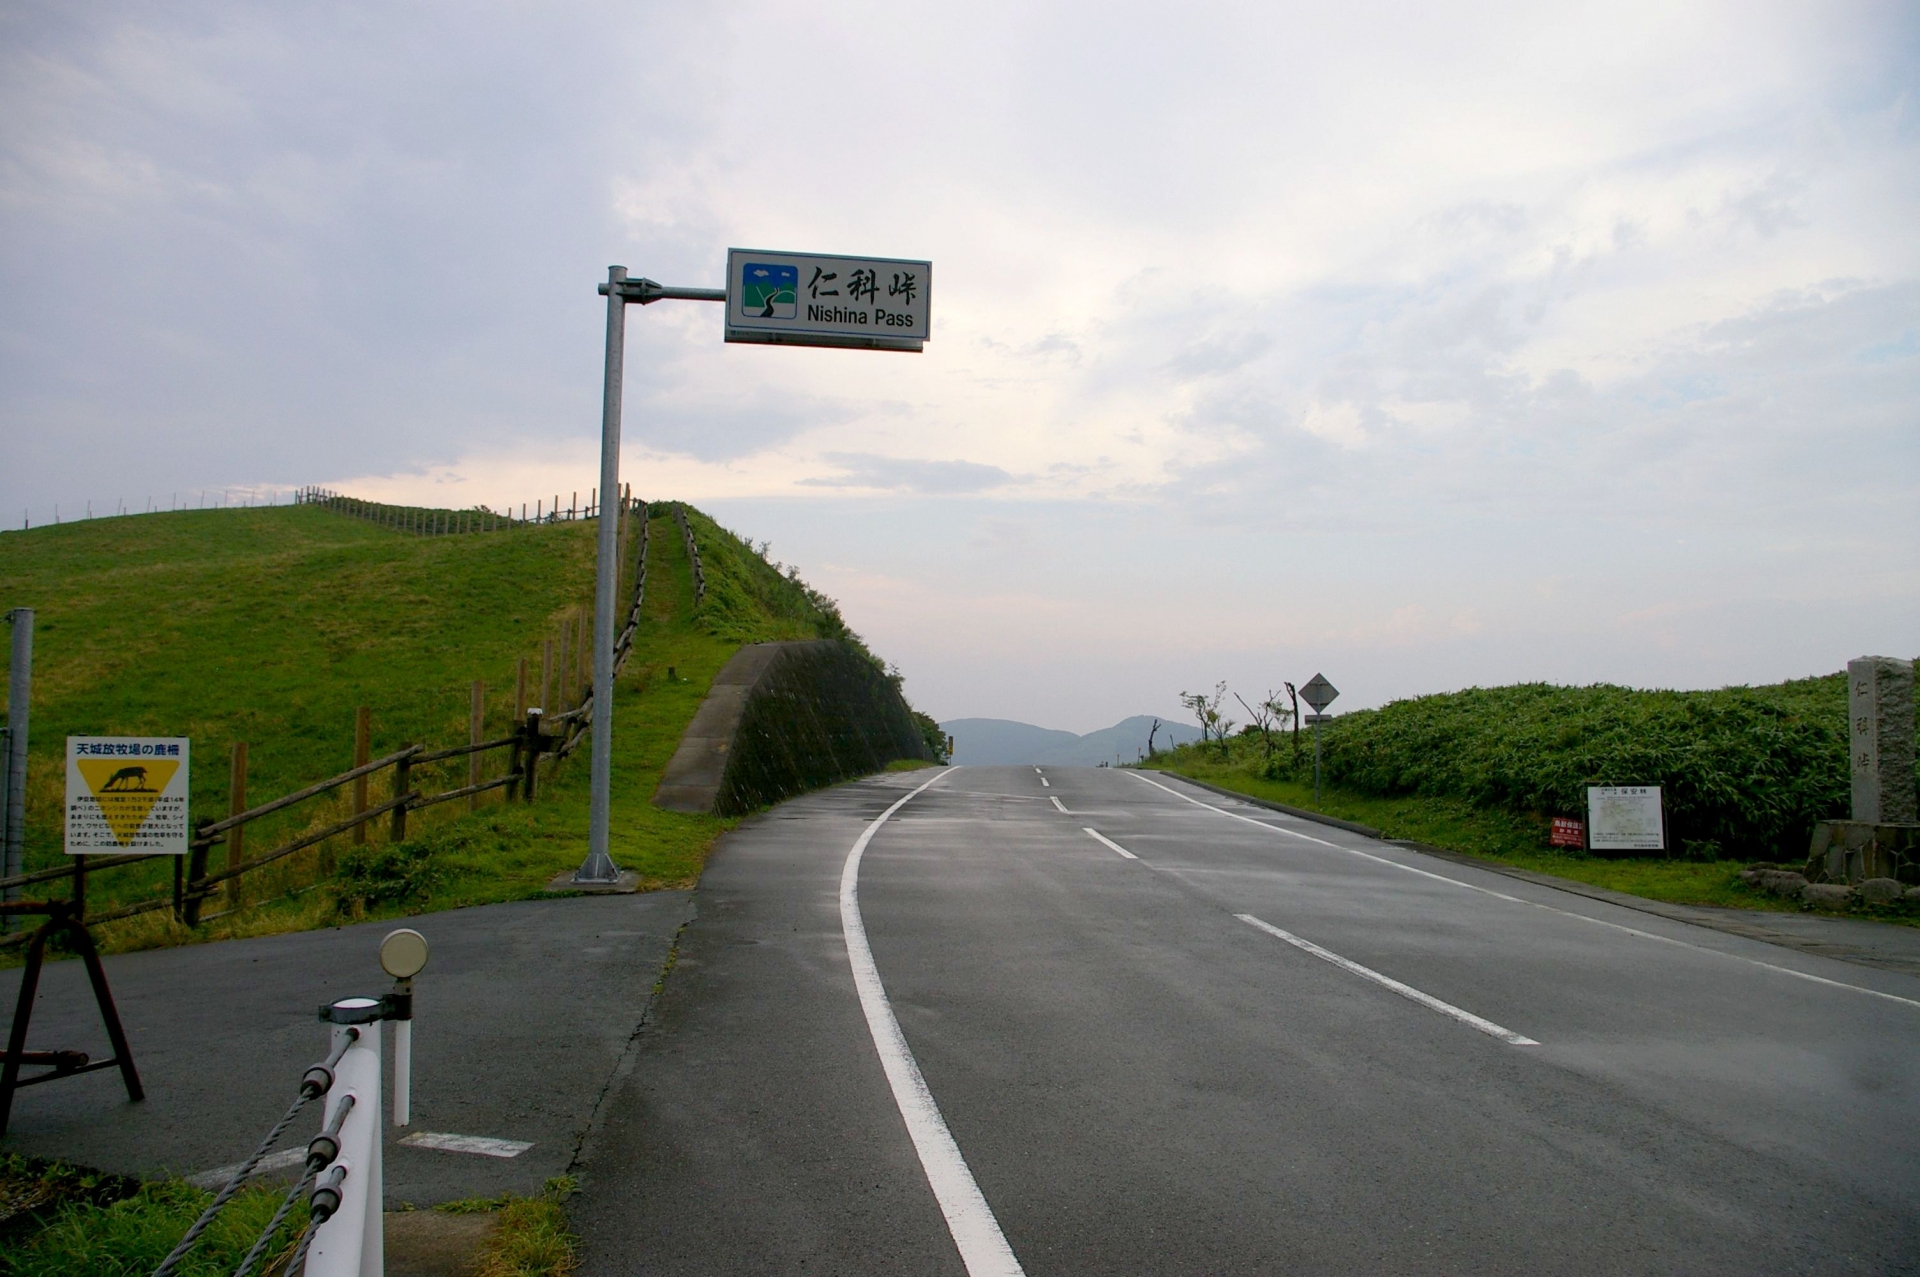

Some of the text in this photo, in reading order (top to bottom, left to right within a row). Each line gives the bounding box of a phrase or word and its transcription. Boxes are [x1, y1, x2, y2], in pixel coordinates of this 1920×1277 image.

[807, 266, 916, 306] 仁科峠
[807, 304, 914, 327] Nishina Pass
[1855, 681, 1870, 772] 仁科峠
[77, 743, 180, 756] 天城放牧場の鹿柵
